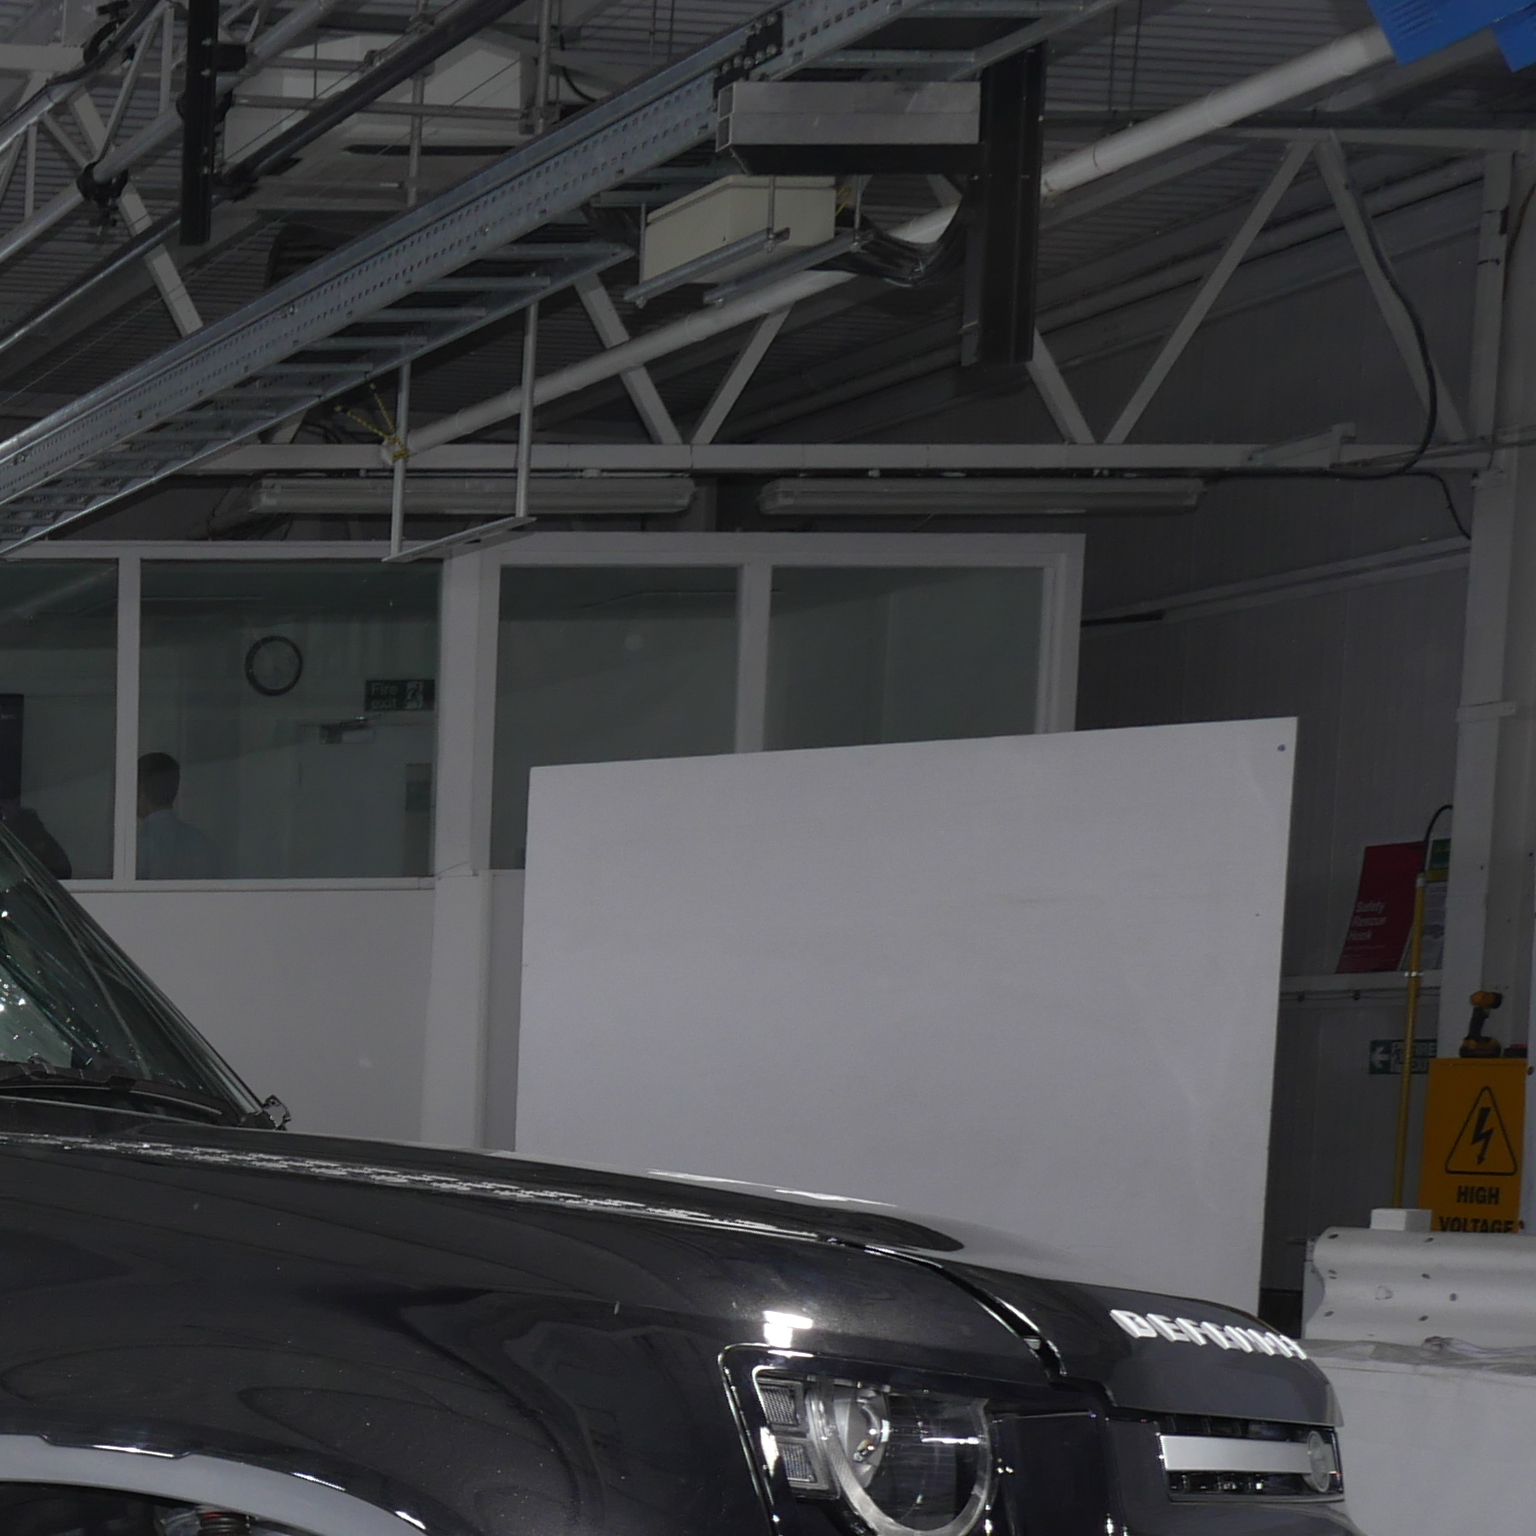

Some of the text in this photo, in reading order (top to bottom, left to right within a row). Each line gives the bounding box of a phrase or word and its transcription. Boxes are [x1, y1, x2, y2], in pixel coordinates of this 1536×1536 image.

[1355, 900, 1387, 915] Safety
[1455, 1185, 1501, 1205] HIGH
[1438, 1216, 1516, 1233] VOLTAGE
